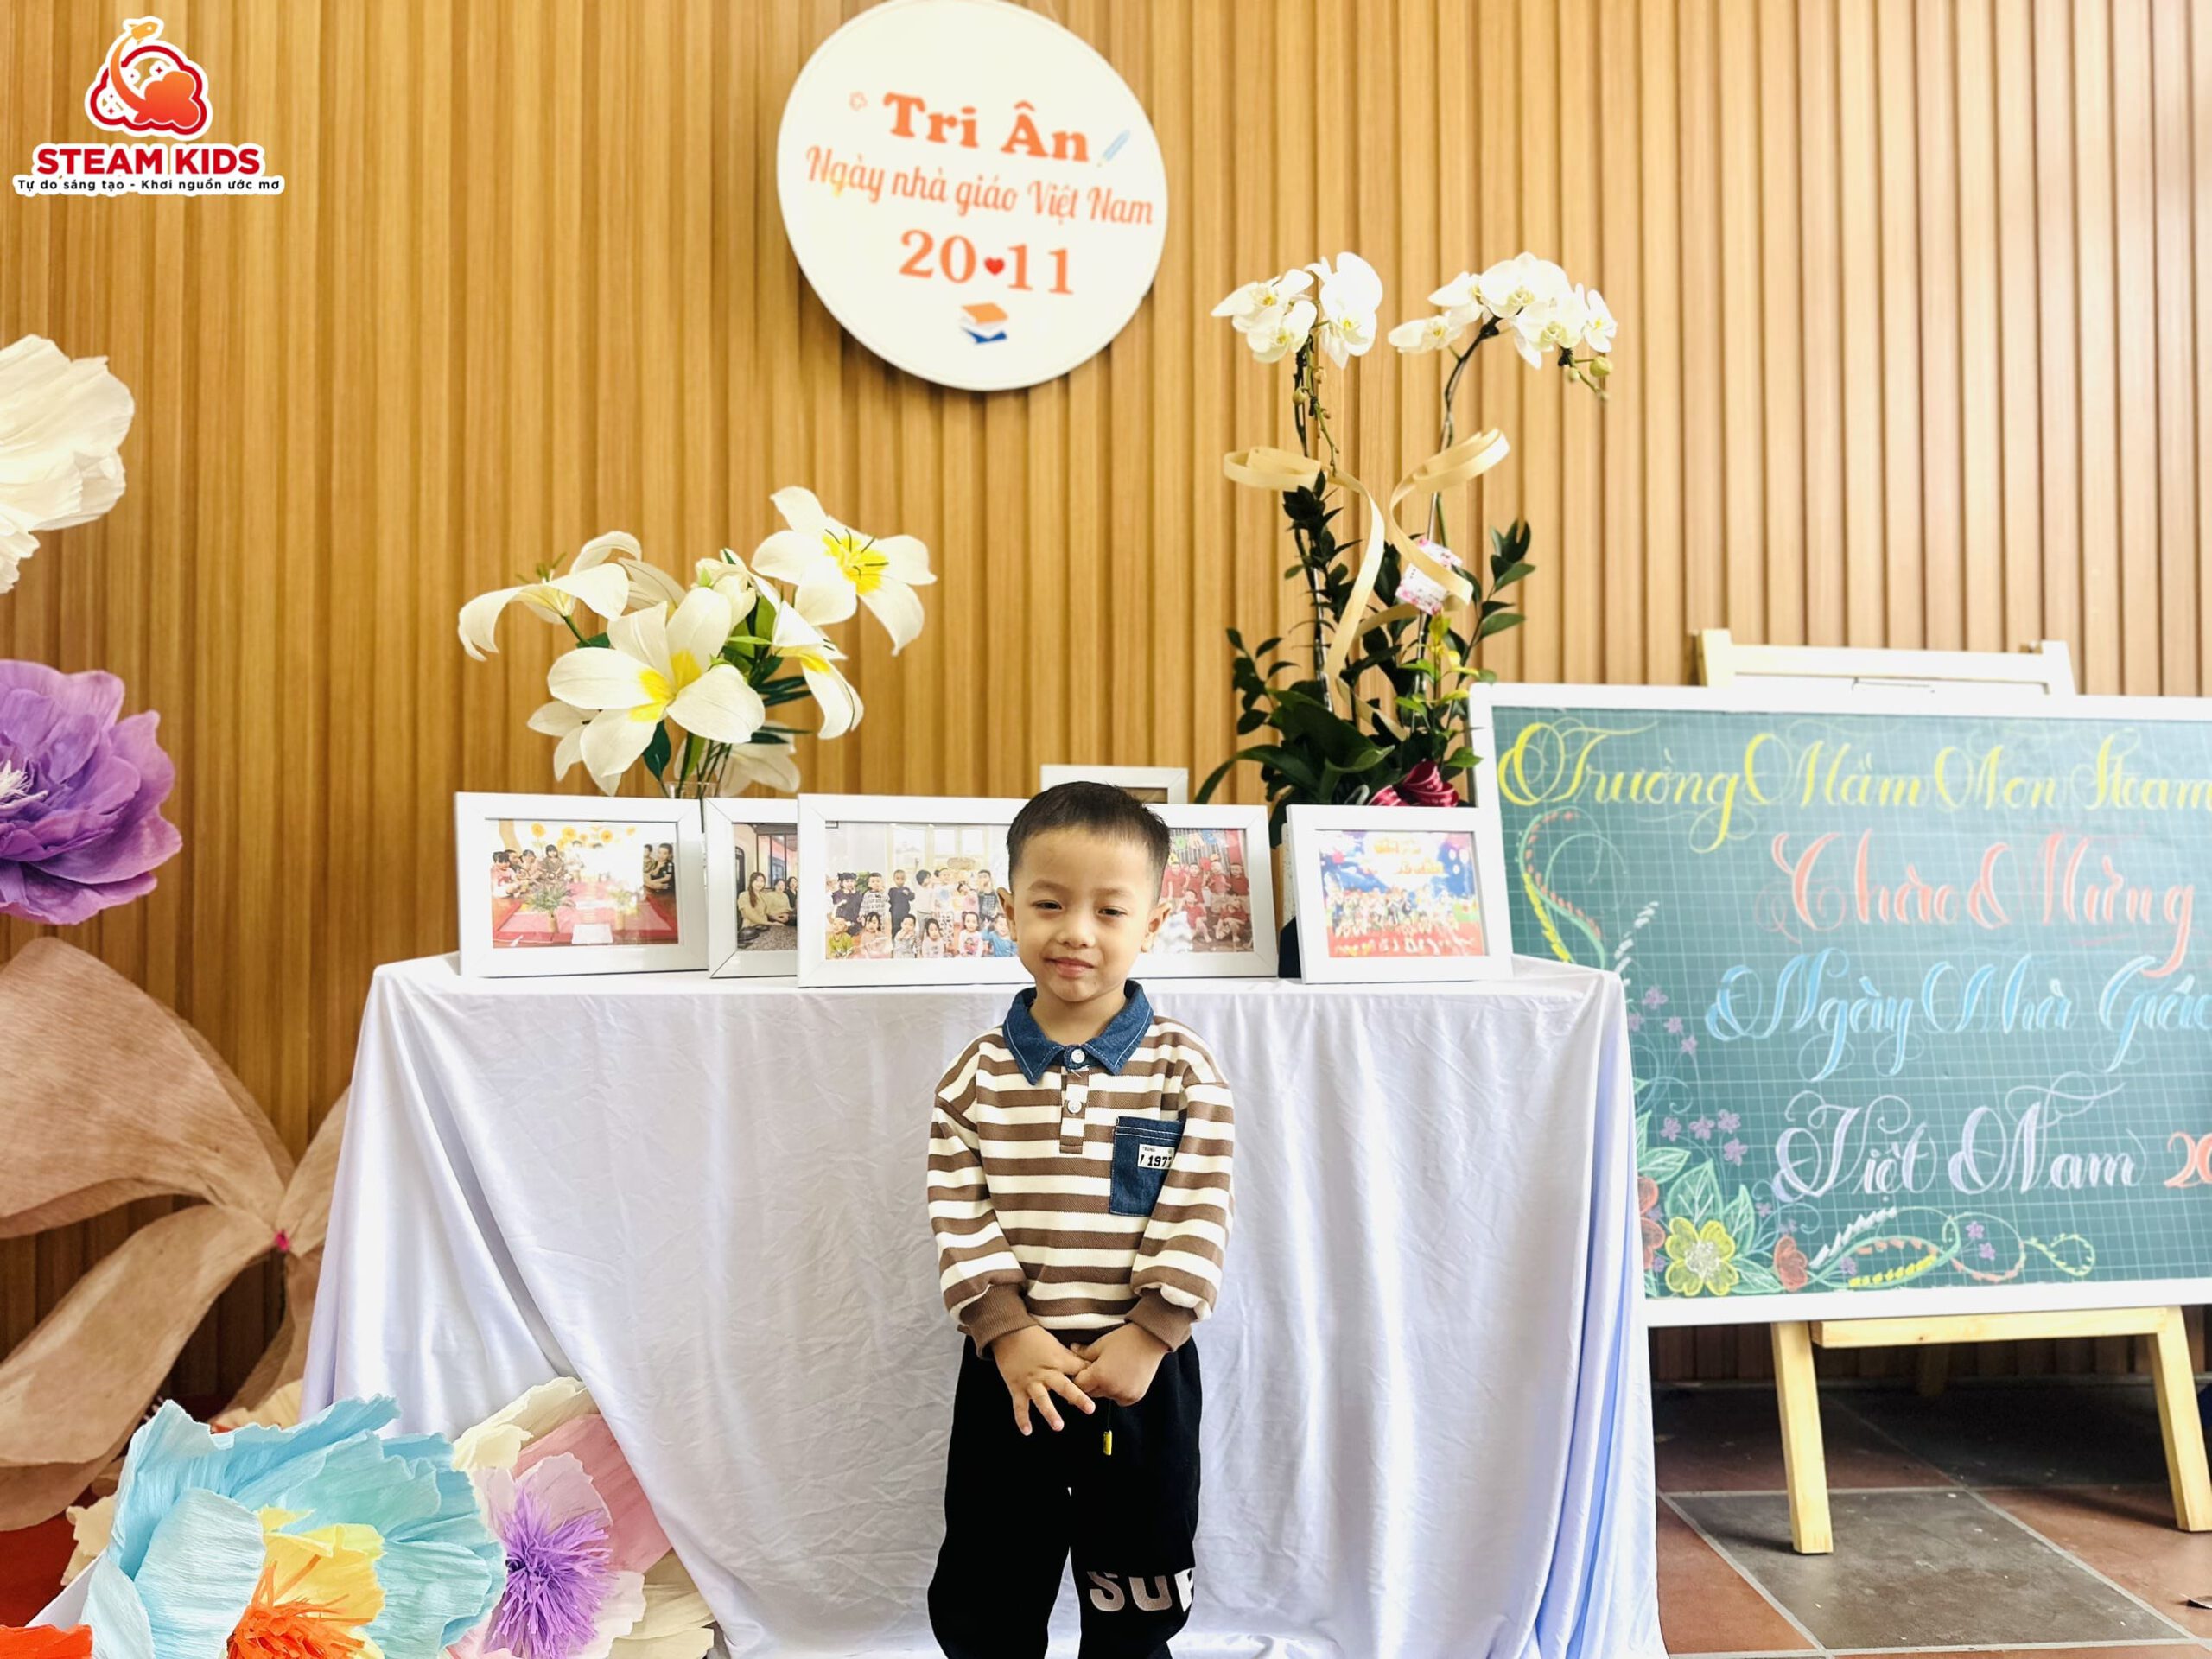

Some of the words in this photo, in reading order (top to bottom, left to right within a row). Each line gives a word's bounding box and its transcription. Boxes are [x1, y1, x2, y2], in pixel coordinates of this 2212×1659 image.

[883, 92, 979, 149] Tri
[1001, 100, 1090, 162] Ân
[805, 145, 885, 204] Ngày
[892, 167, 948, 202] nhà
[955, 174, 1018, 216] giáo
[1027, 180, 1079, 226] Việt
[1087, 187, 1153, 225] Nam
[899, 229, 976, 283] 20
[1007, 244, 1074, 295] 11
[1497, 717, 1750, 854] Trường
[1758, 828, 1960, 938] Chào
[1705, 947, 1920, 1082] Ngày
[1921, 953, 2074, 1034] Nhà
[1773, 1090, 1937, 1203] Việt
[1948, 1080, 2146, 1195] Nam
